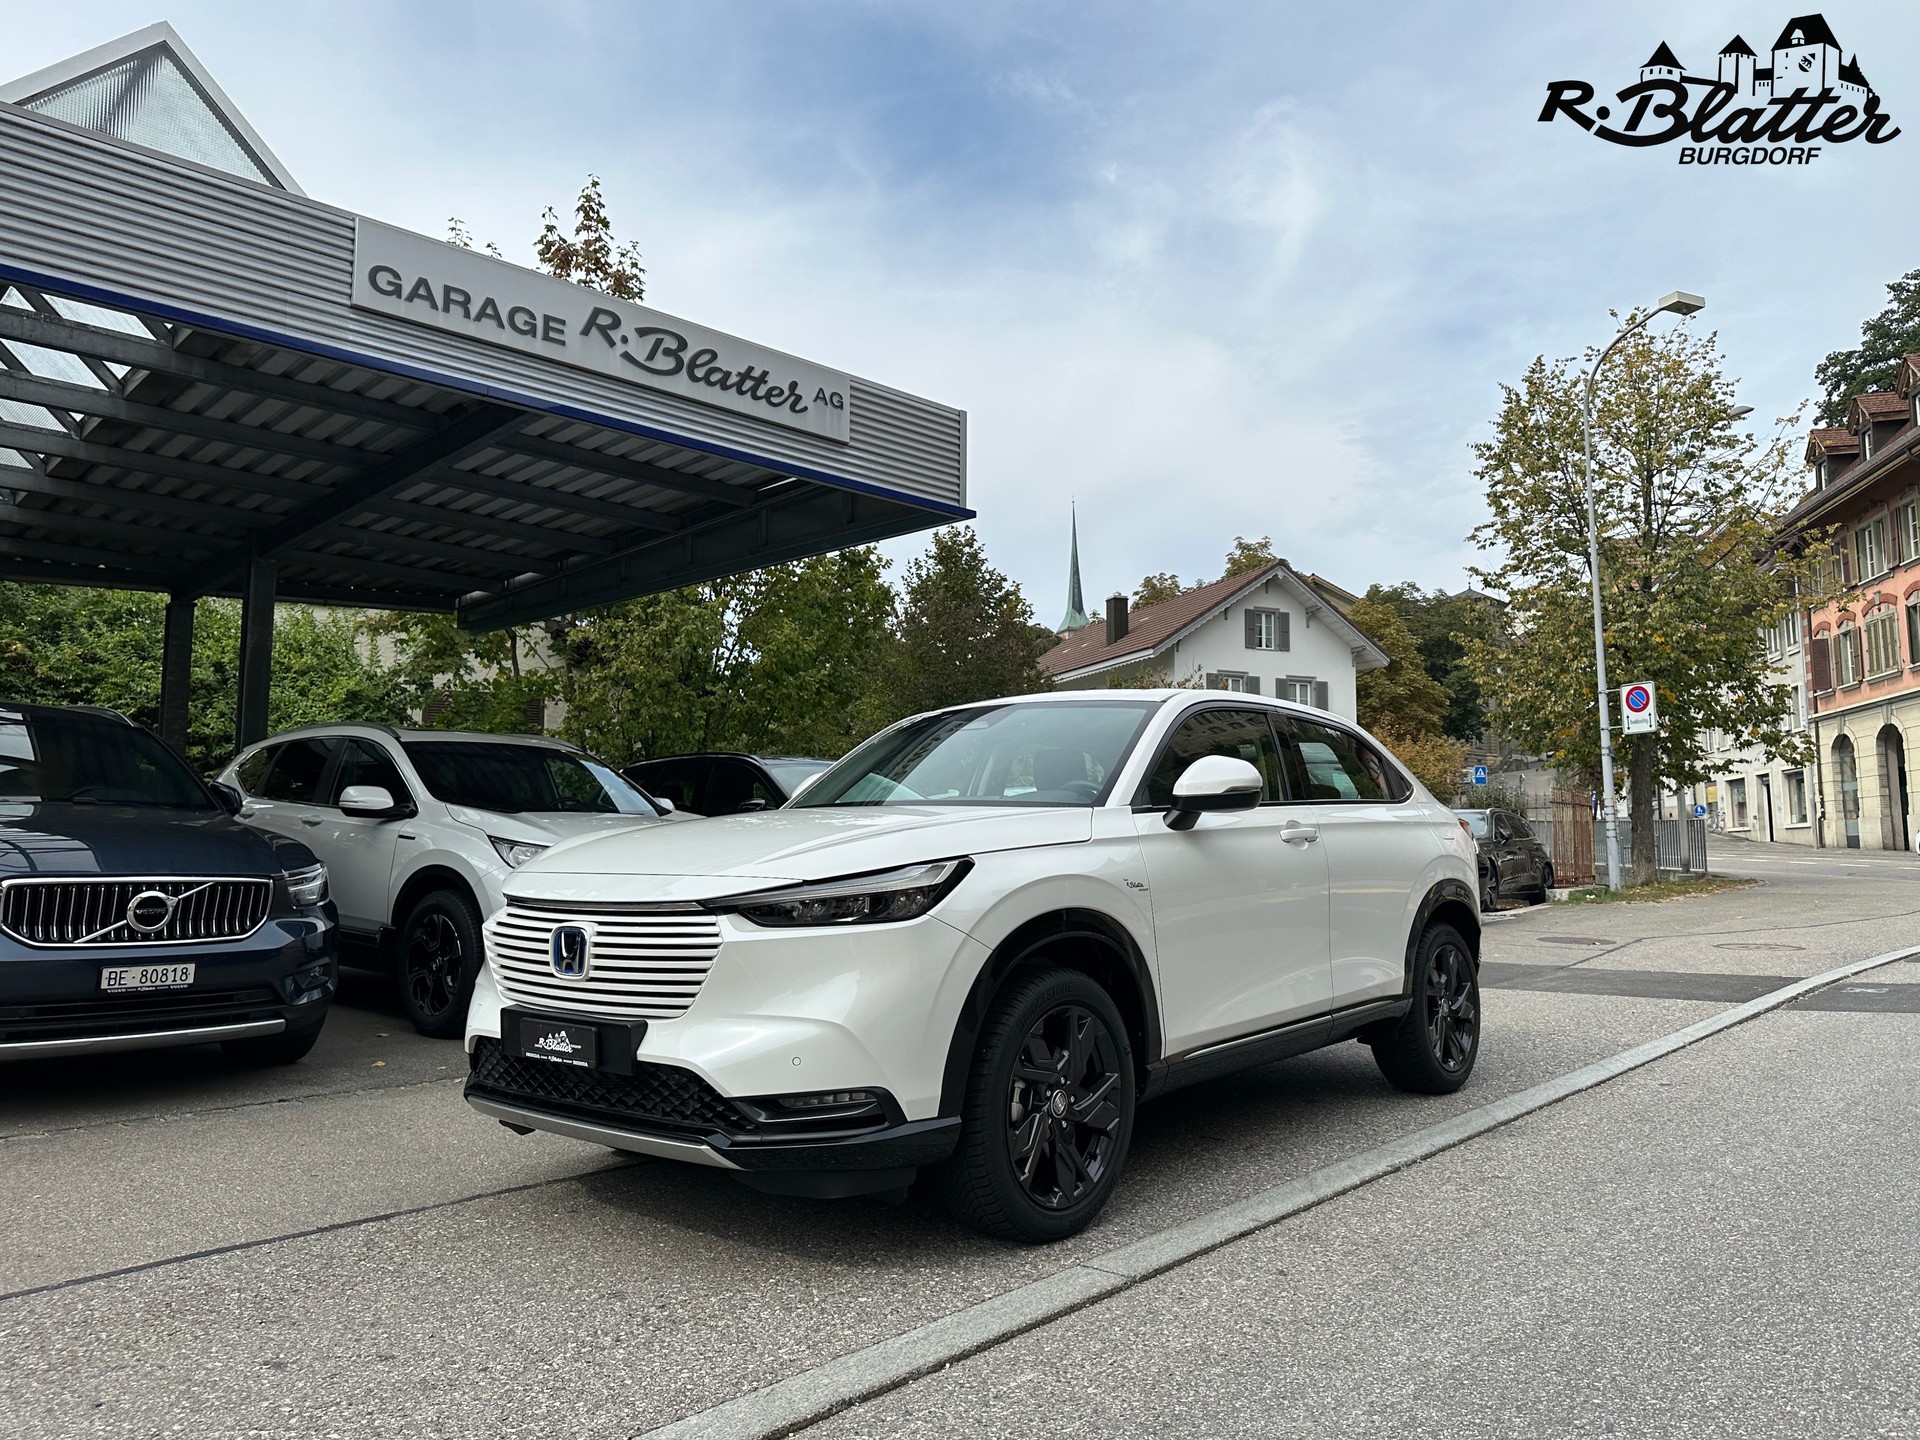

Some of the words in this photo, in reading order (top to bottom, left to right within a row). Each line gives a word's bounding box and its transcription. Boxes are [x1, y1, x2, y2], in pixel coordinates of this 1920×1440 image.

[367, 264, 567, 347] GARAGE
[813, 387, 845, 411] AG
[107, 970, 129, 987] BE
[139, 966, 189, 985] 80818
